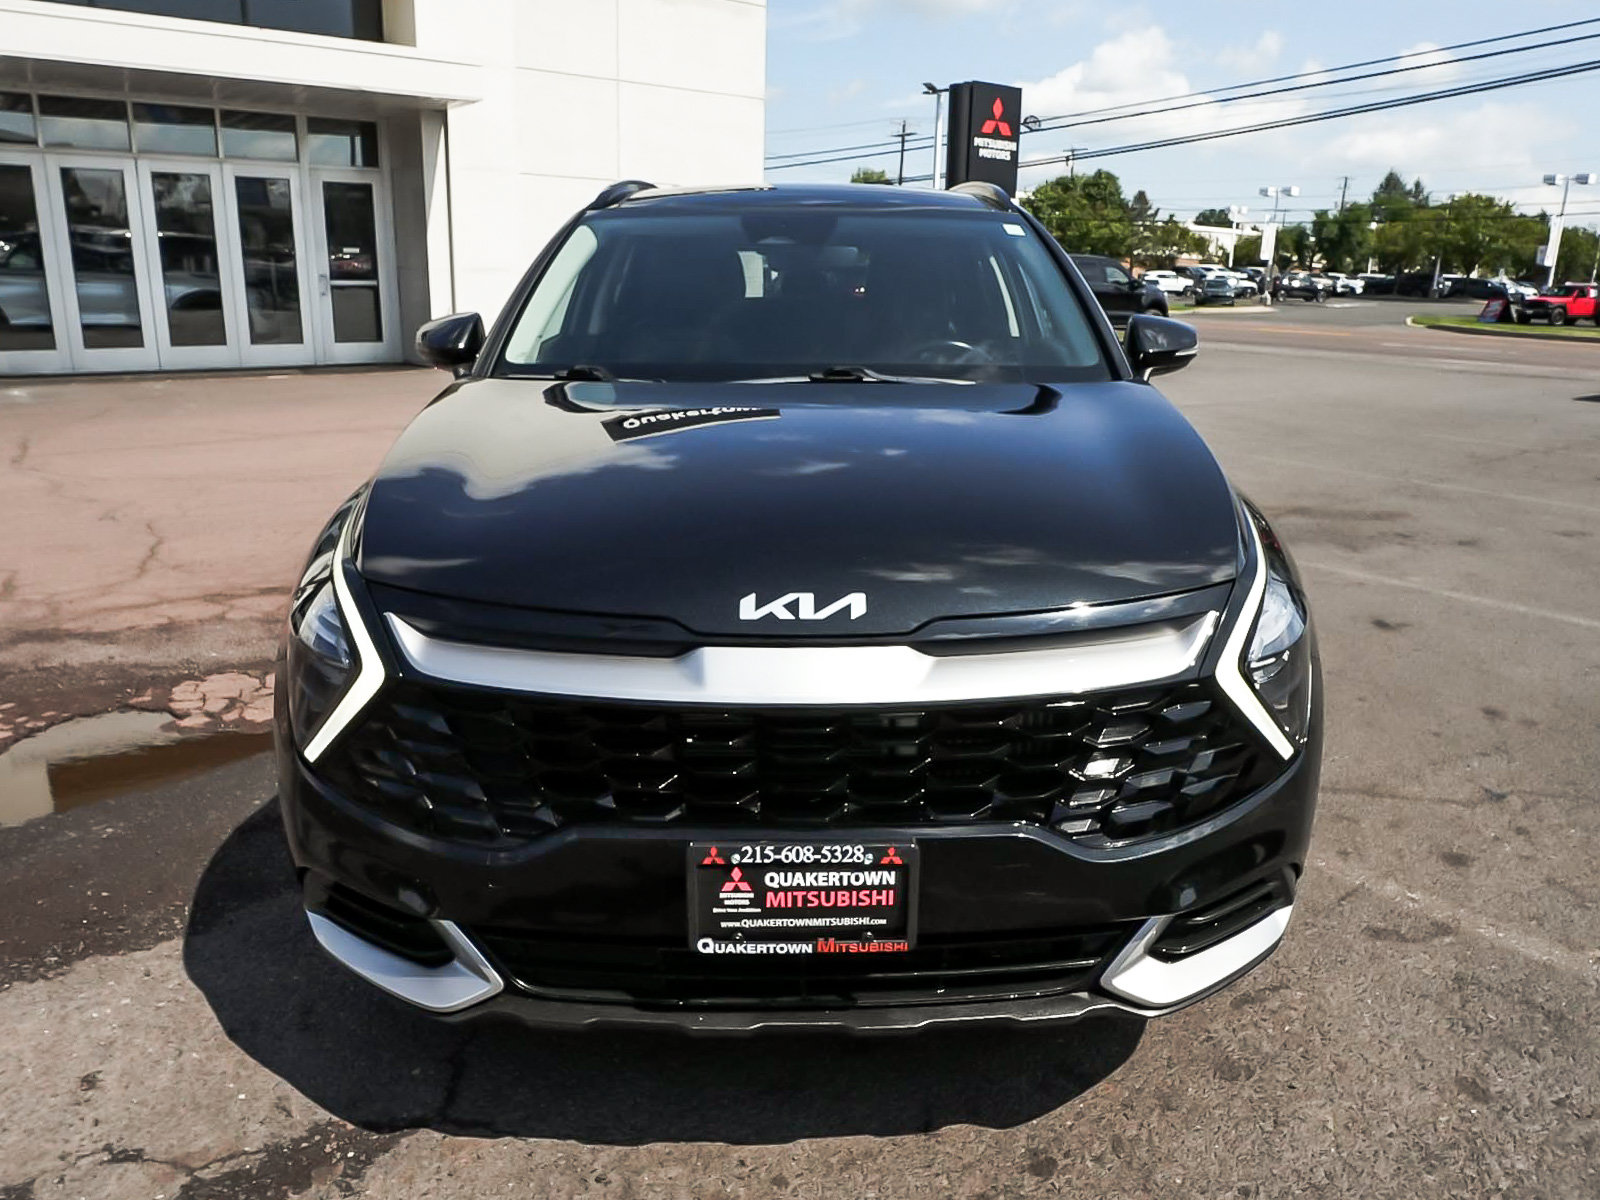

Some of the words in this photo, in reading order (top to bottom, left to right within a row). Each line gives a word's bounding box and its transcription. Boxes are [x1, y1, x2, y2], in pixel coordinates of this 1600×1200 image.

[739, 592, 867, 620] KIA
[740, 845, 865, 863] 215-608-5328
[764, 871, 896, 888] QUAKERTOWN
[766, 889, 894, 908] MITSUBISHI
[720, 917, 887, 928] www.QUAKERTOWNMITSUBISHI.com
[697, 937, 813, 954] QUAKERTOWN
[816, 937, 909, 953] MITSUBISHI
